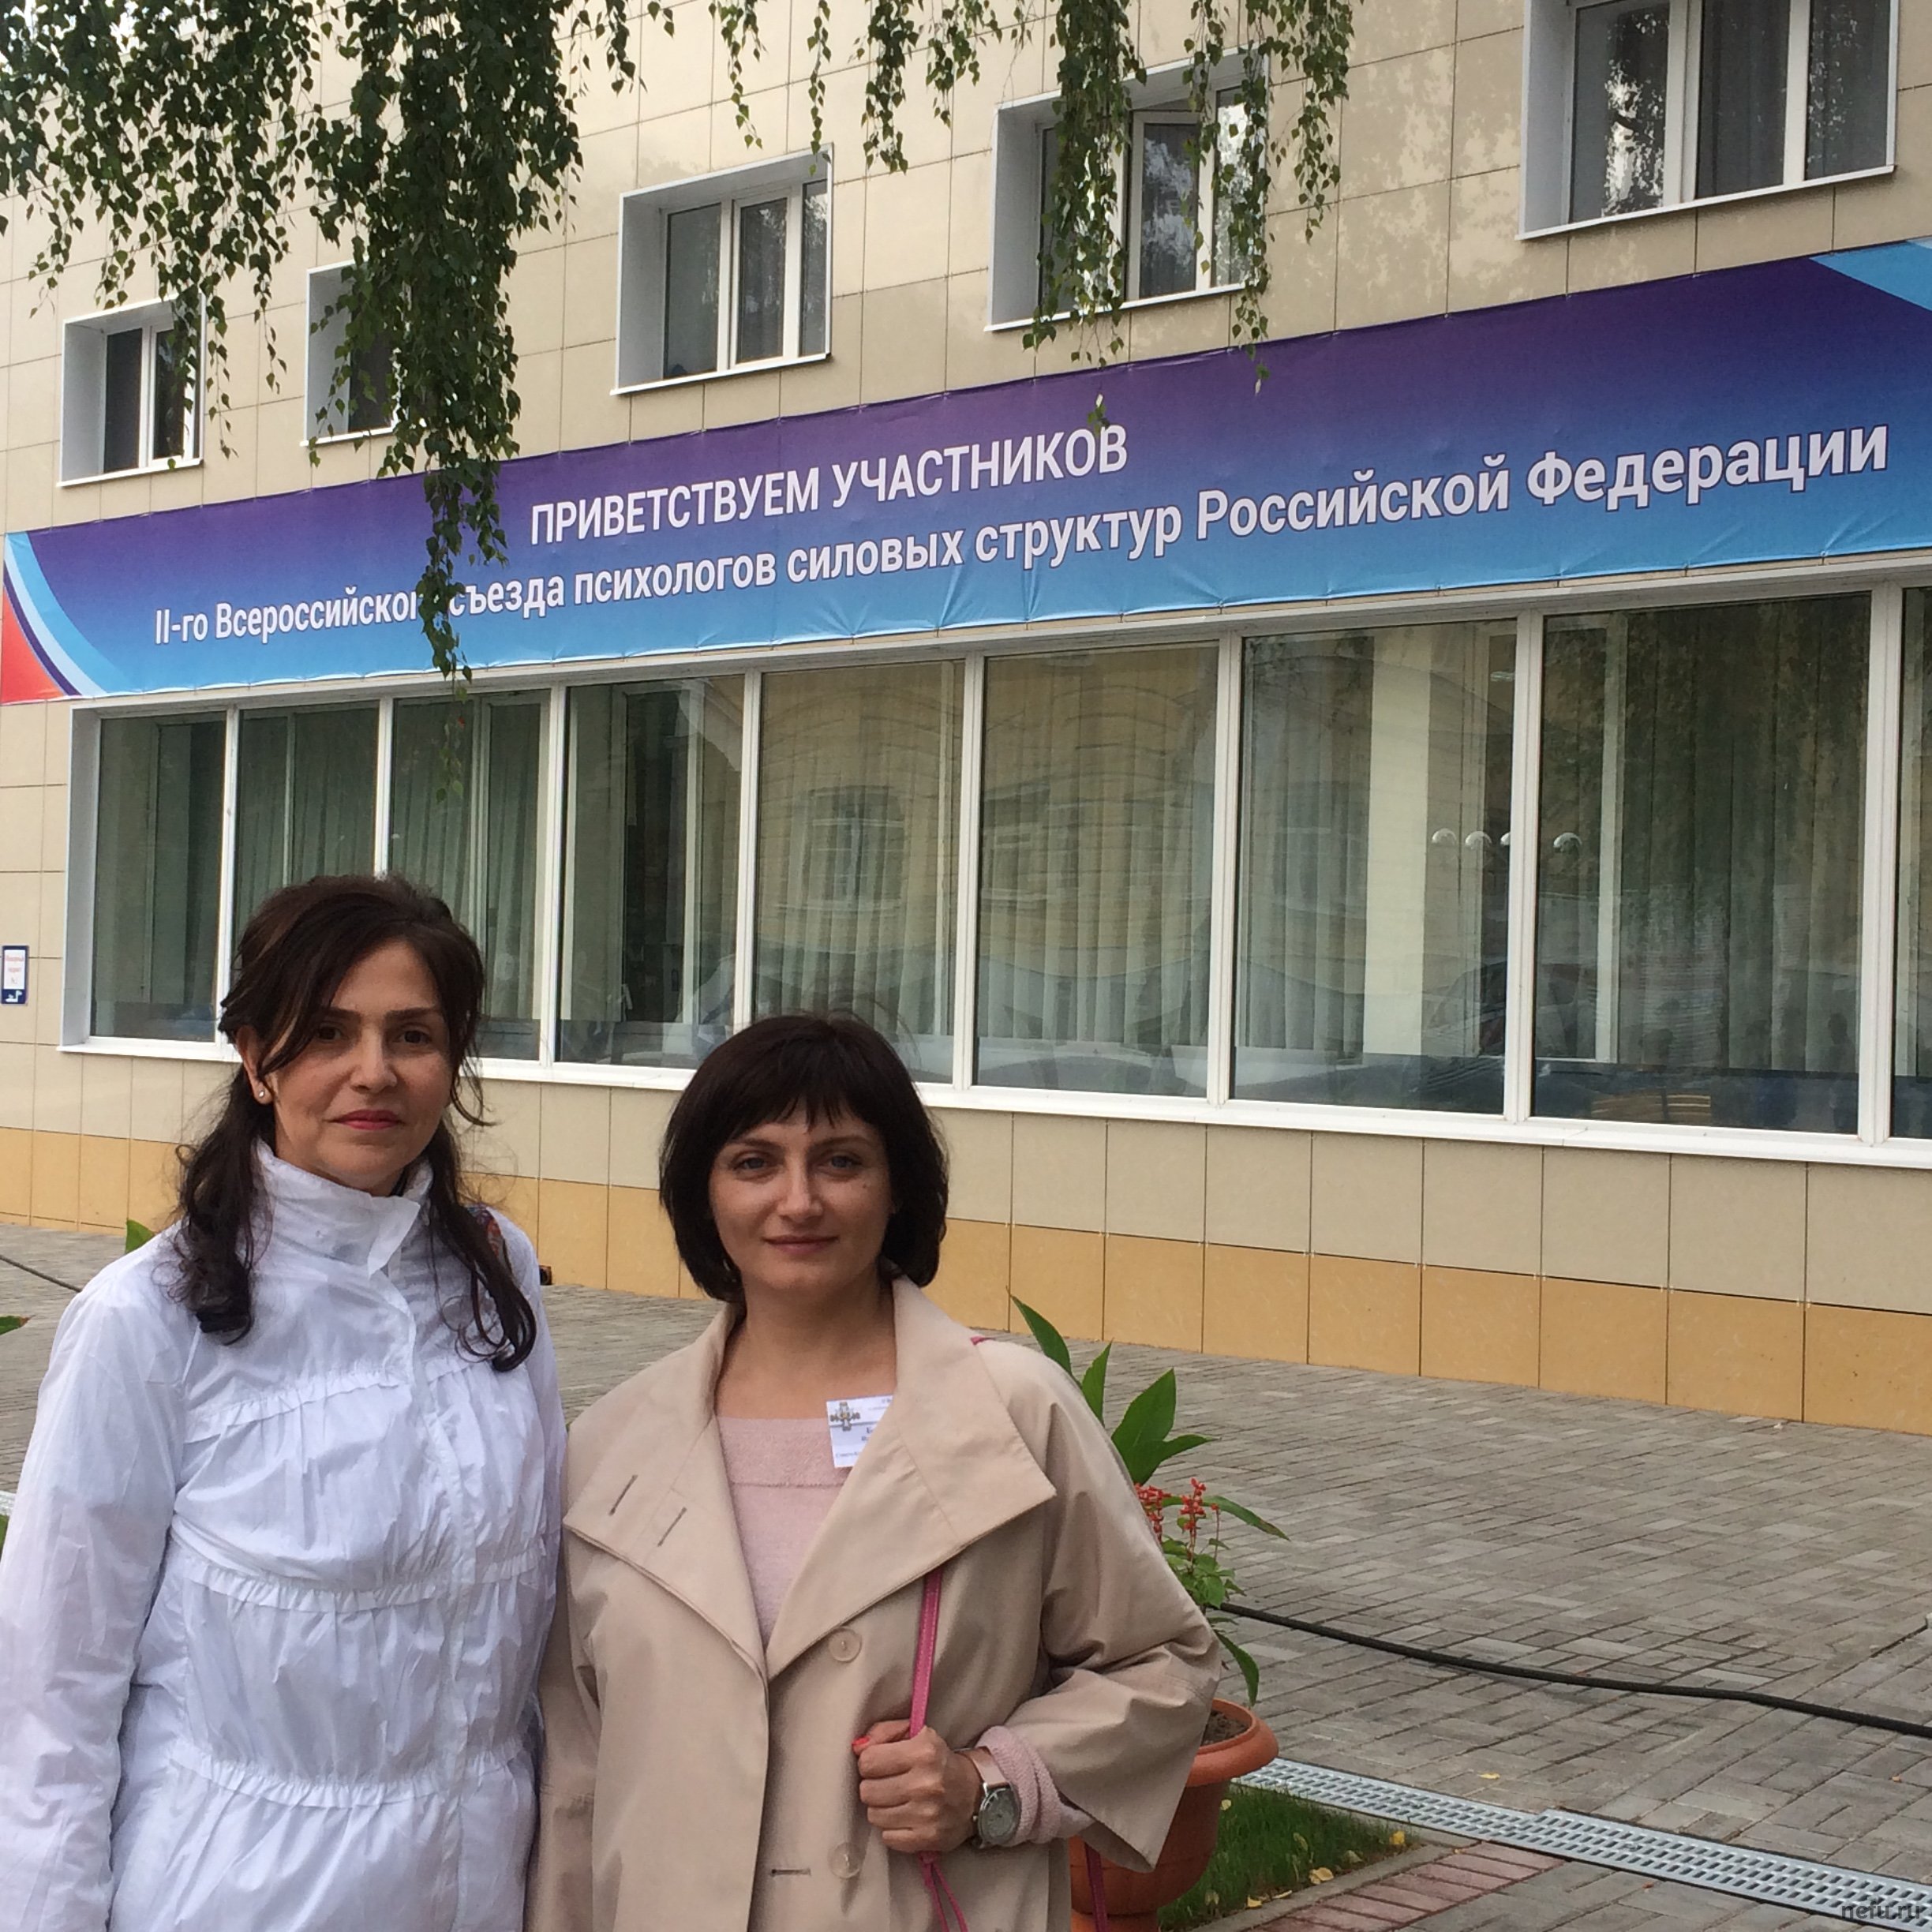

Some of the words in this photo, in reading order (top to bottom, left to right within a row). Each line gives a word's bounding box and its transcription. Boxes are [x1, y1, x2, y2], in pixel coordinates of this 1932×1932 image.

[155, 608, 208, 645] II-го
[215, 586, 442, 643] Всероссийског
[448, 575, 564, 619] съезда
[574, 552, 777, 605] психологов
[788, 530, 964, 583] силовых
[975, 503, 1182, 571] структур
[1197, 454, 1510, 541] Российской
[1526, 425, 1889, 511] Федерации
[530, 466, 821, 545] ПРИВЕТСТВУЕМ
[833, 424, 1128, 509] УЧАСТНИКОВ
